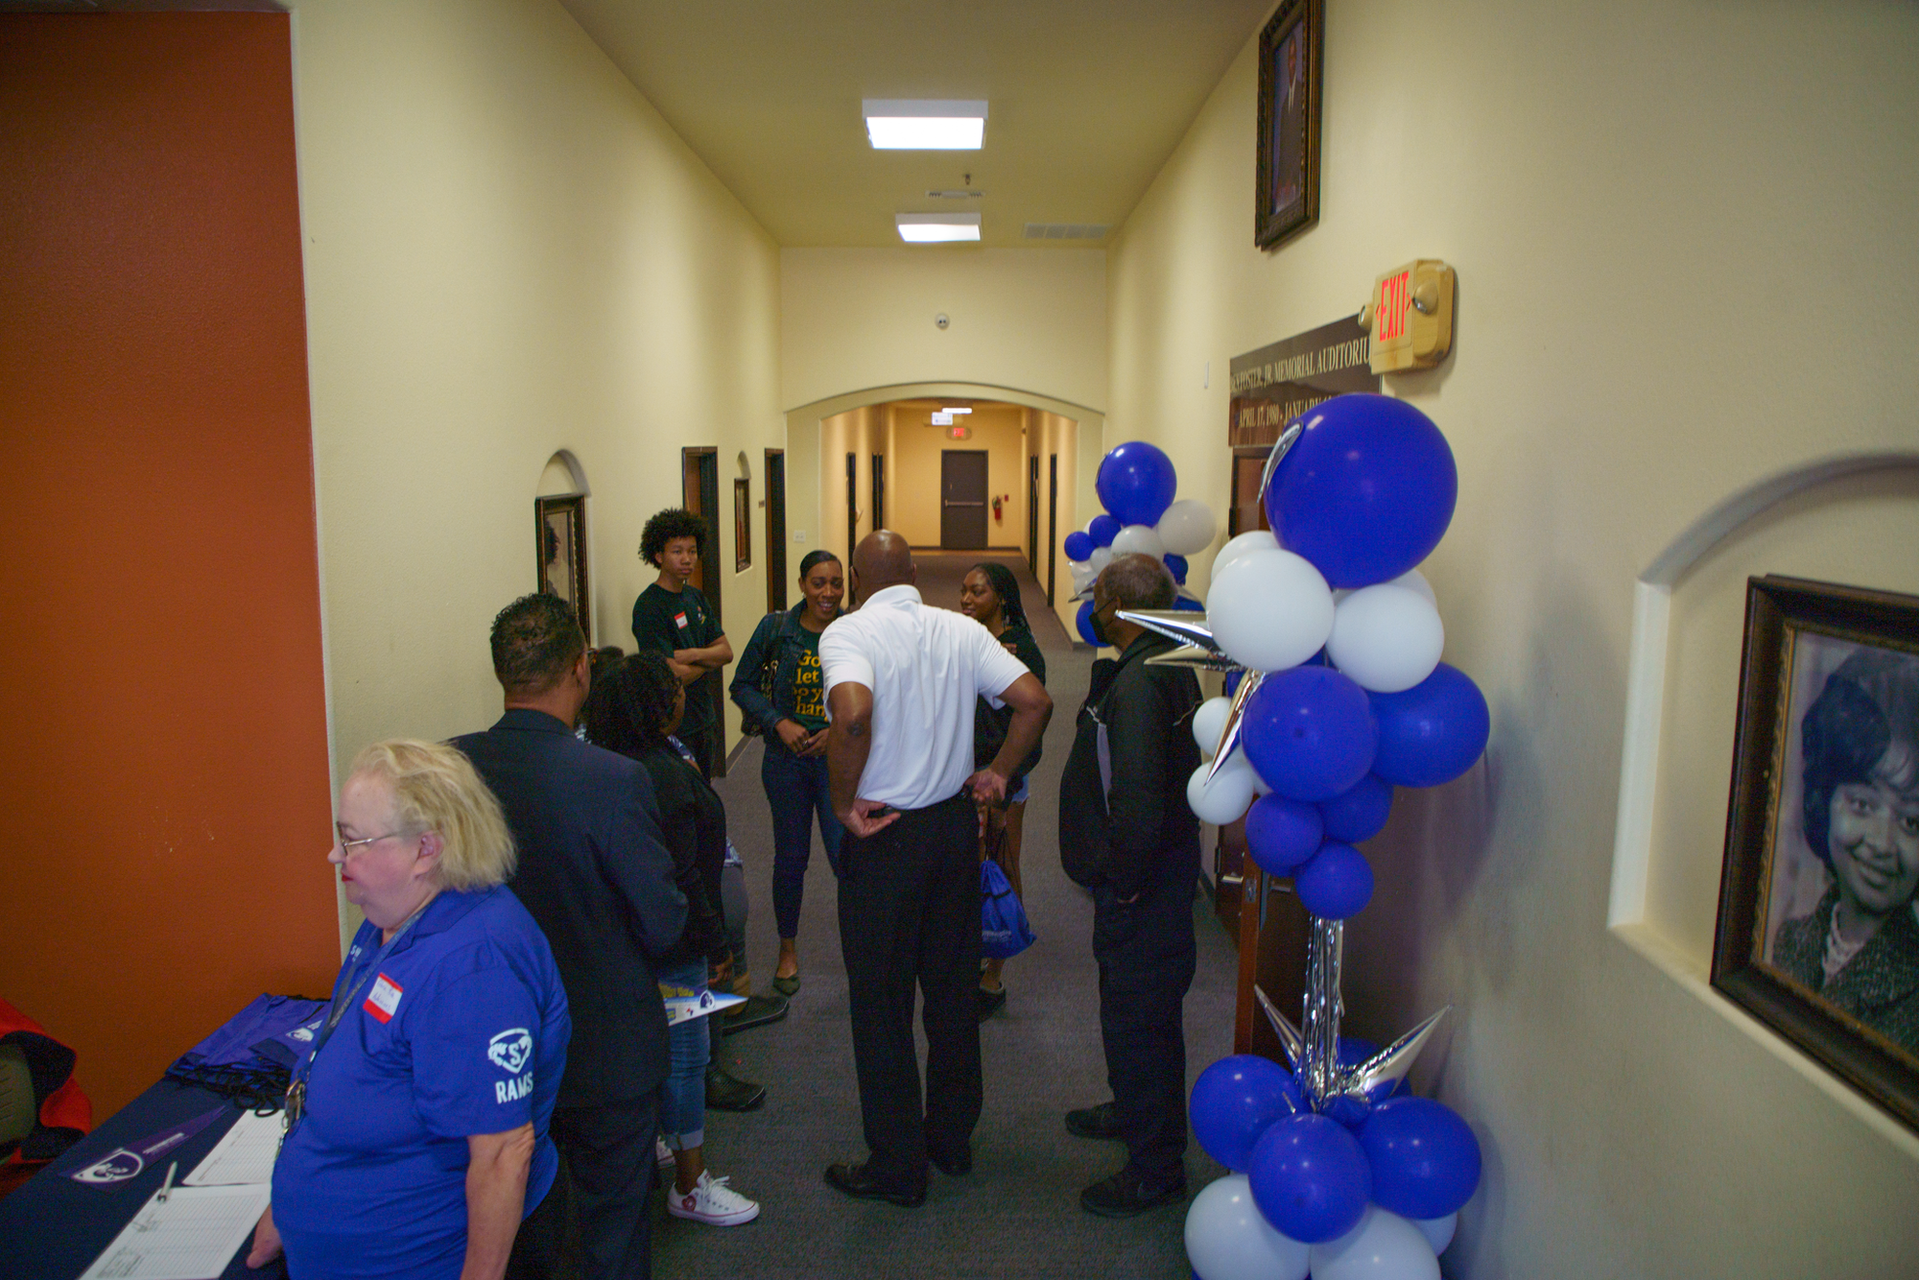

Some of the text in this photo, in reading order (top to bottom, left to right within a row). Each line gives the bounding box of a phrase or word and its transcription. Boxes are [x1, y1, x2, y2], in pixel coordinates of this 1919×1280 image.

[1380, 271, 1409, 342] EXIT
[1275, 351, 1315, 383] MEMORIAL
[1316, 335, 1370, 375] AUDITORIU
[1239, 407, 1256, 428] APRIL
[1284, 397, 1322, 427] JANUA
[795, 667, 819, 684] let
[496, 1071, 534, 1105] RAMS
